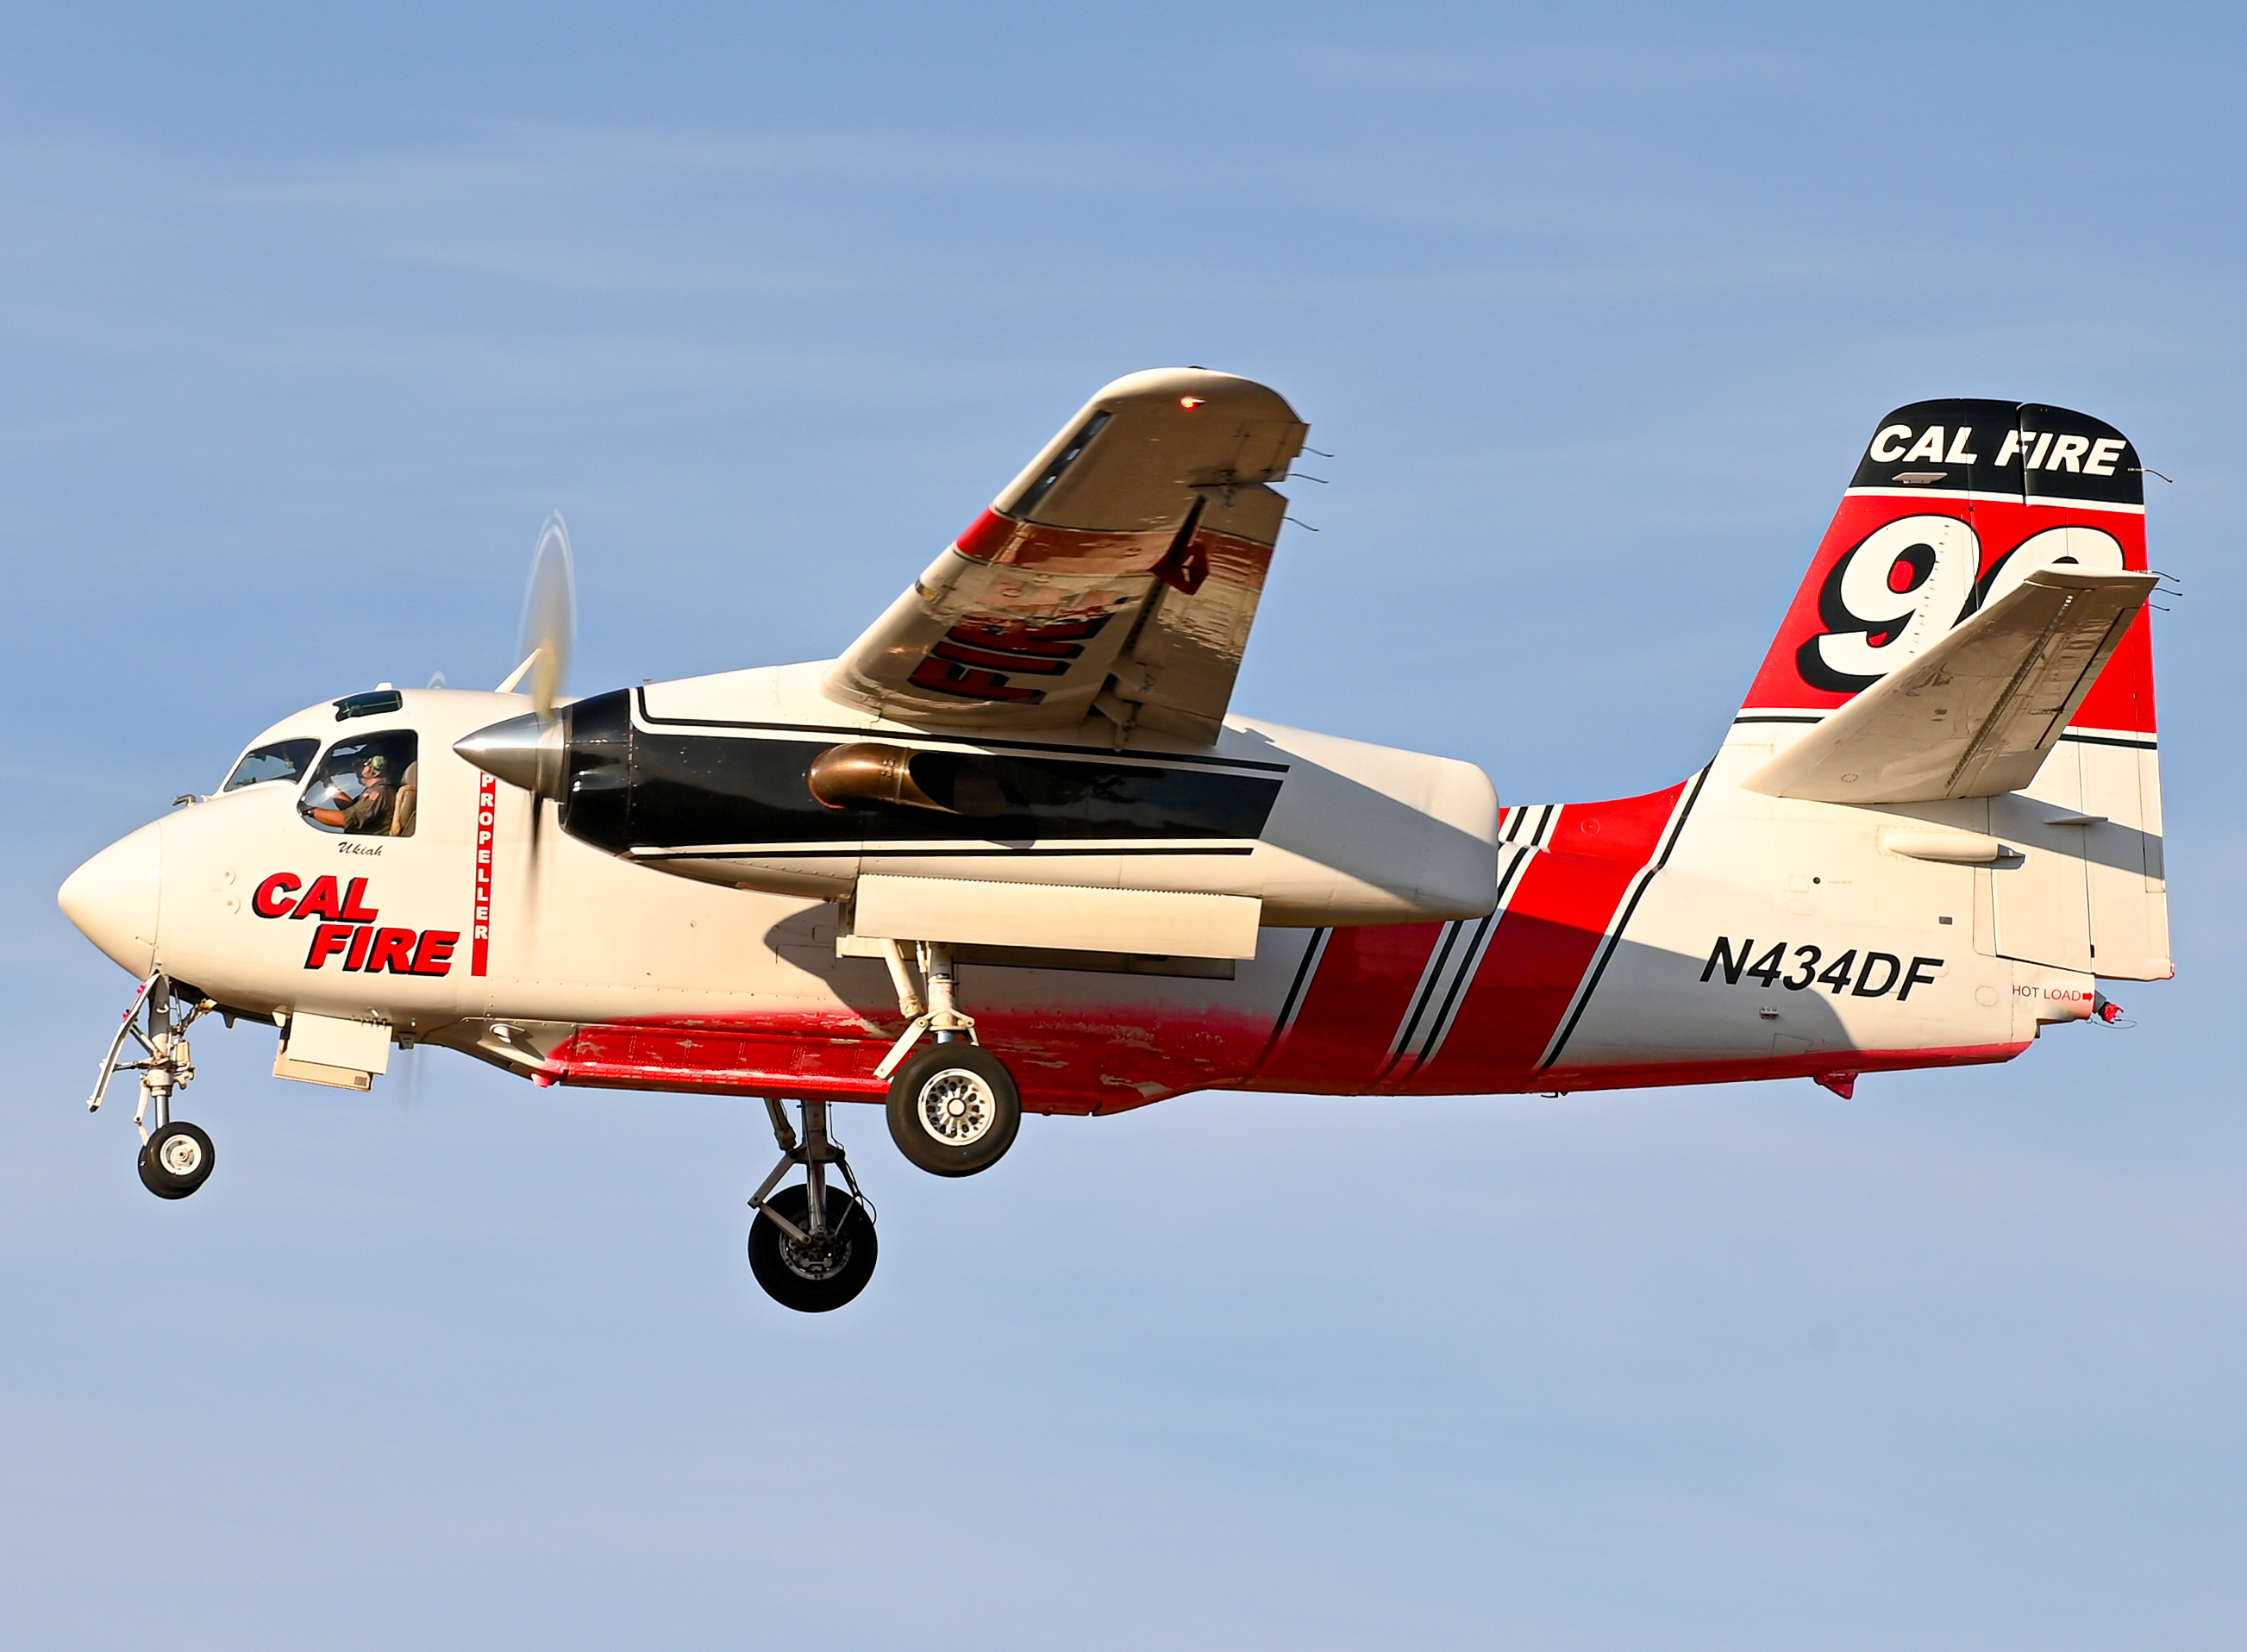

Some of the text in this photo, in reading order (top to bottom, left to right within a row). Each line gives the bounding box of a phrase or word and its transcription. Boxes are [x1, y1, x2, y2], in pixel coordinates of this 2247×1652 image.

[1869, 424, 2126, 475] CAL FIRE
[338, 842, 383, 856] Ukiah
[474, 773, 494, 940] PROPELLER
[252, 872, 379, 924] CAL
[304, 923, 461, 977] FIRE
[1699, 936, 1944, 1001] N434DF
[2012, 985, 2081, 1001] HOT LOAD
